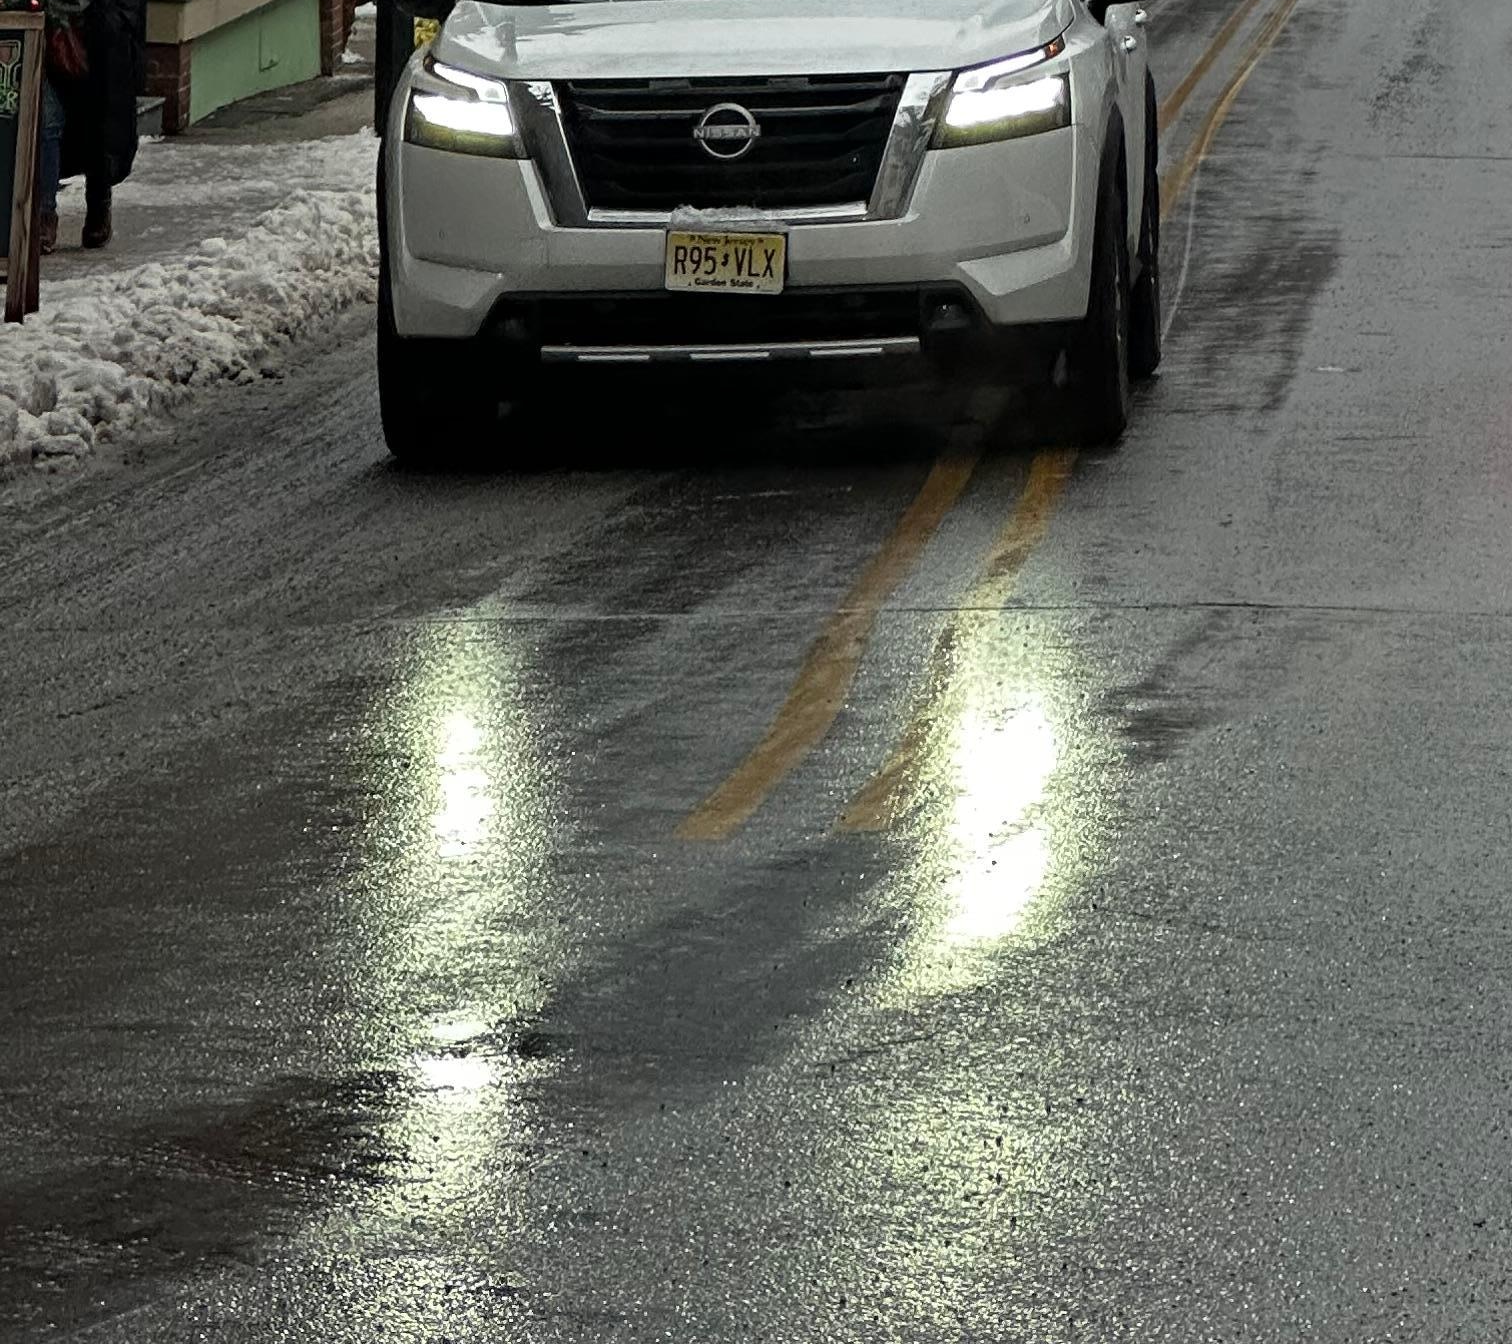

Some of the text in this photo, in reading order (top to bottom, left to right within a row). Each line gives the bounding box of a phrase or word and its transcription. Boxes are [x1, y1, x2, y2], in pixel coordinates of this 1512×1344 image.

[693, 124, 761, 140] NISSAN
[674, 245, 776, 278] R95 VLX
